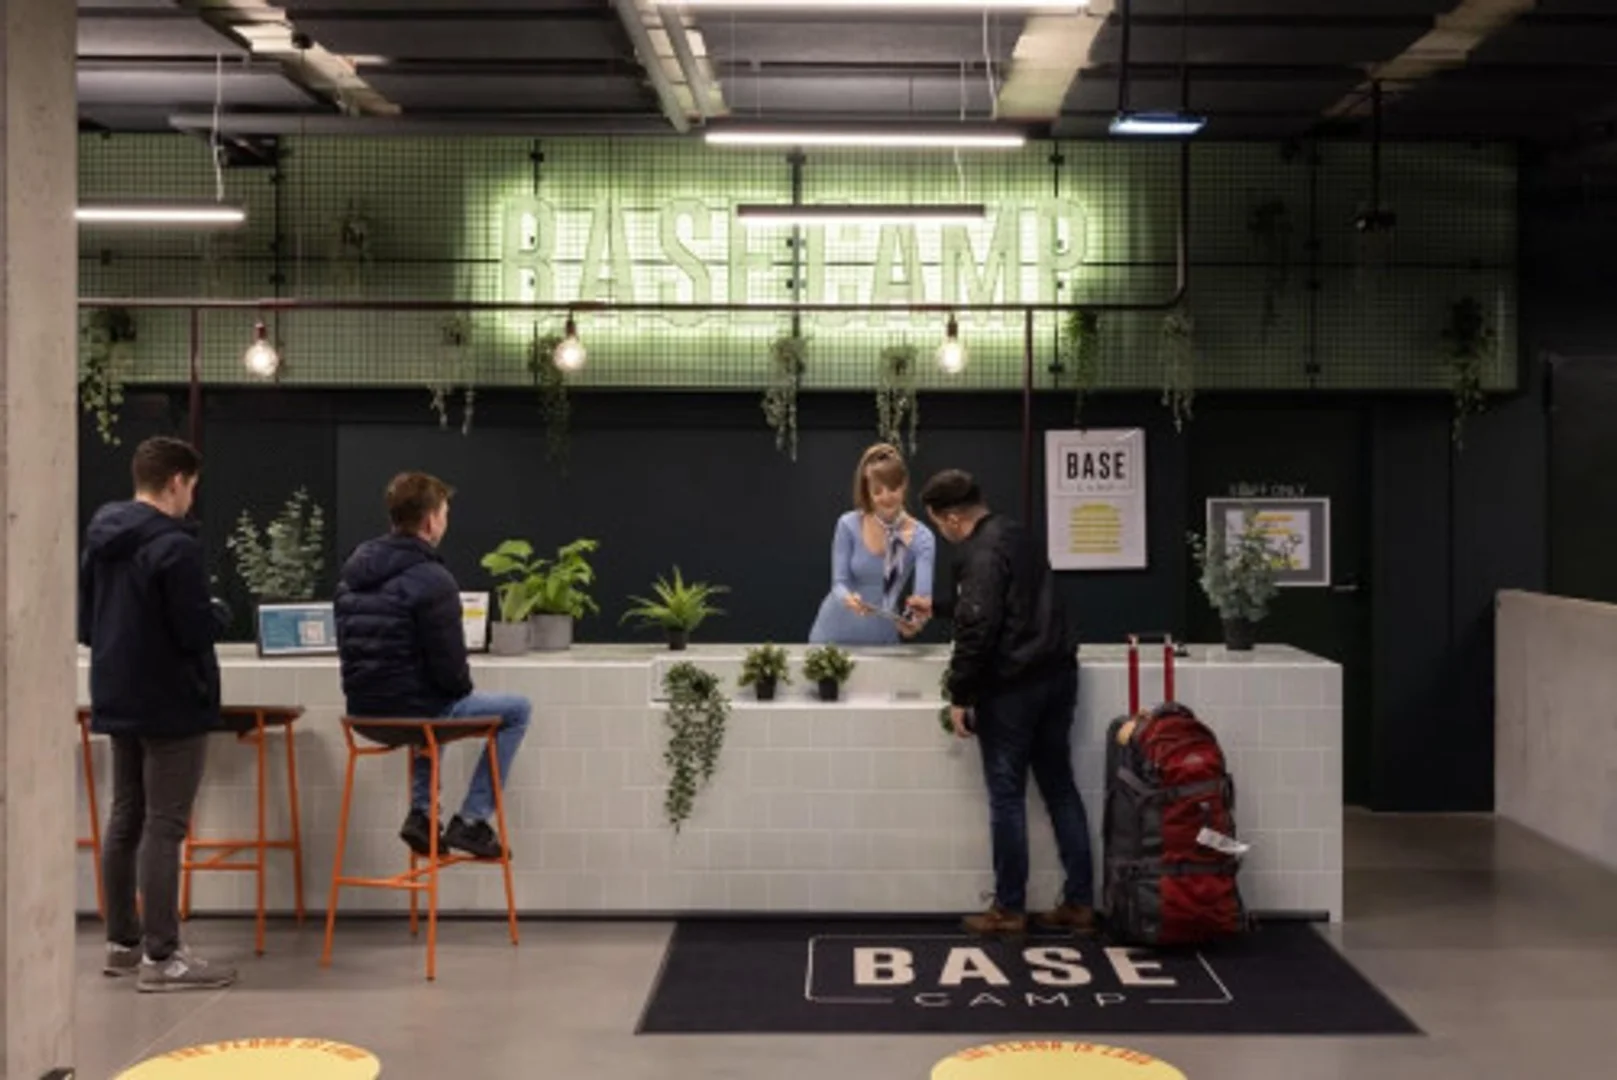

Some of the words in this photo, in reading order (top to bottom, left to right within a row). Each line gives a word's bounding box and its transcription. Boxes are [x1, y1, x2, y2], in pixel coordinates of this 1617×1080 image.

[1066, 452, 1127, 480] BASE
[853, 946, 1178, 987] BASE
[914, 992, 1127, 1007] CAMP
